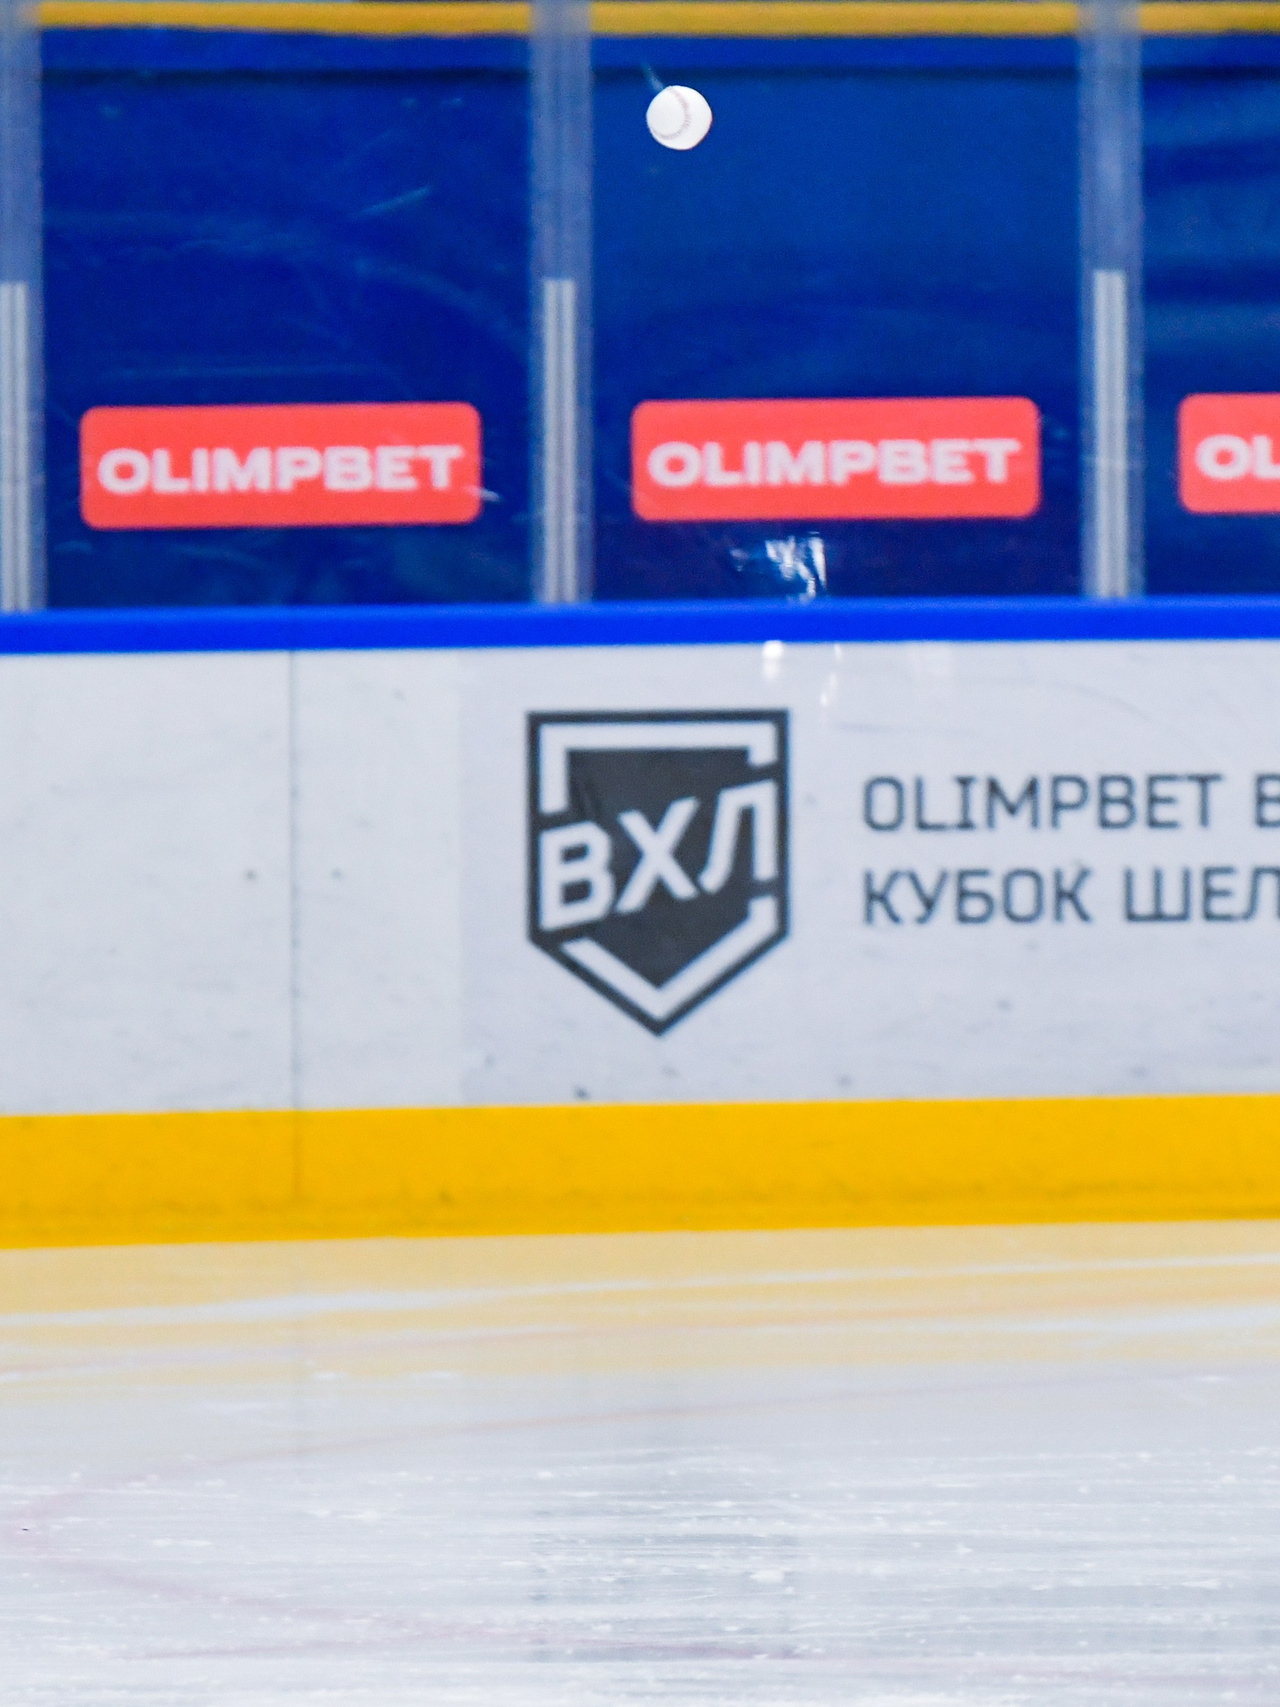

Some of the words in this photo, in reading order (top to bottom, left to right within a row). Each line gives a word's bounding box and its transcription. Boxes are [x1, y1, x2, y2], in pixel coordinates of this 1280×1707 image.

[97, 443, 465, 495] OLIMPBET
[646, 437, 1021, 488] OLIMPBET
[862, 772, 1223, 834] OLIMPBET
[538, 777, 778, 932] ВХЛ
[862, 866, 1092, 925] КУБОК
